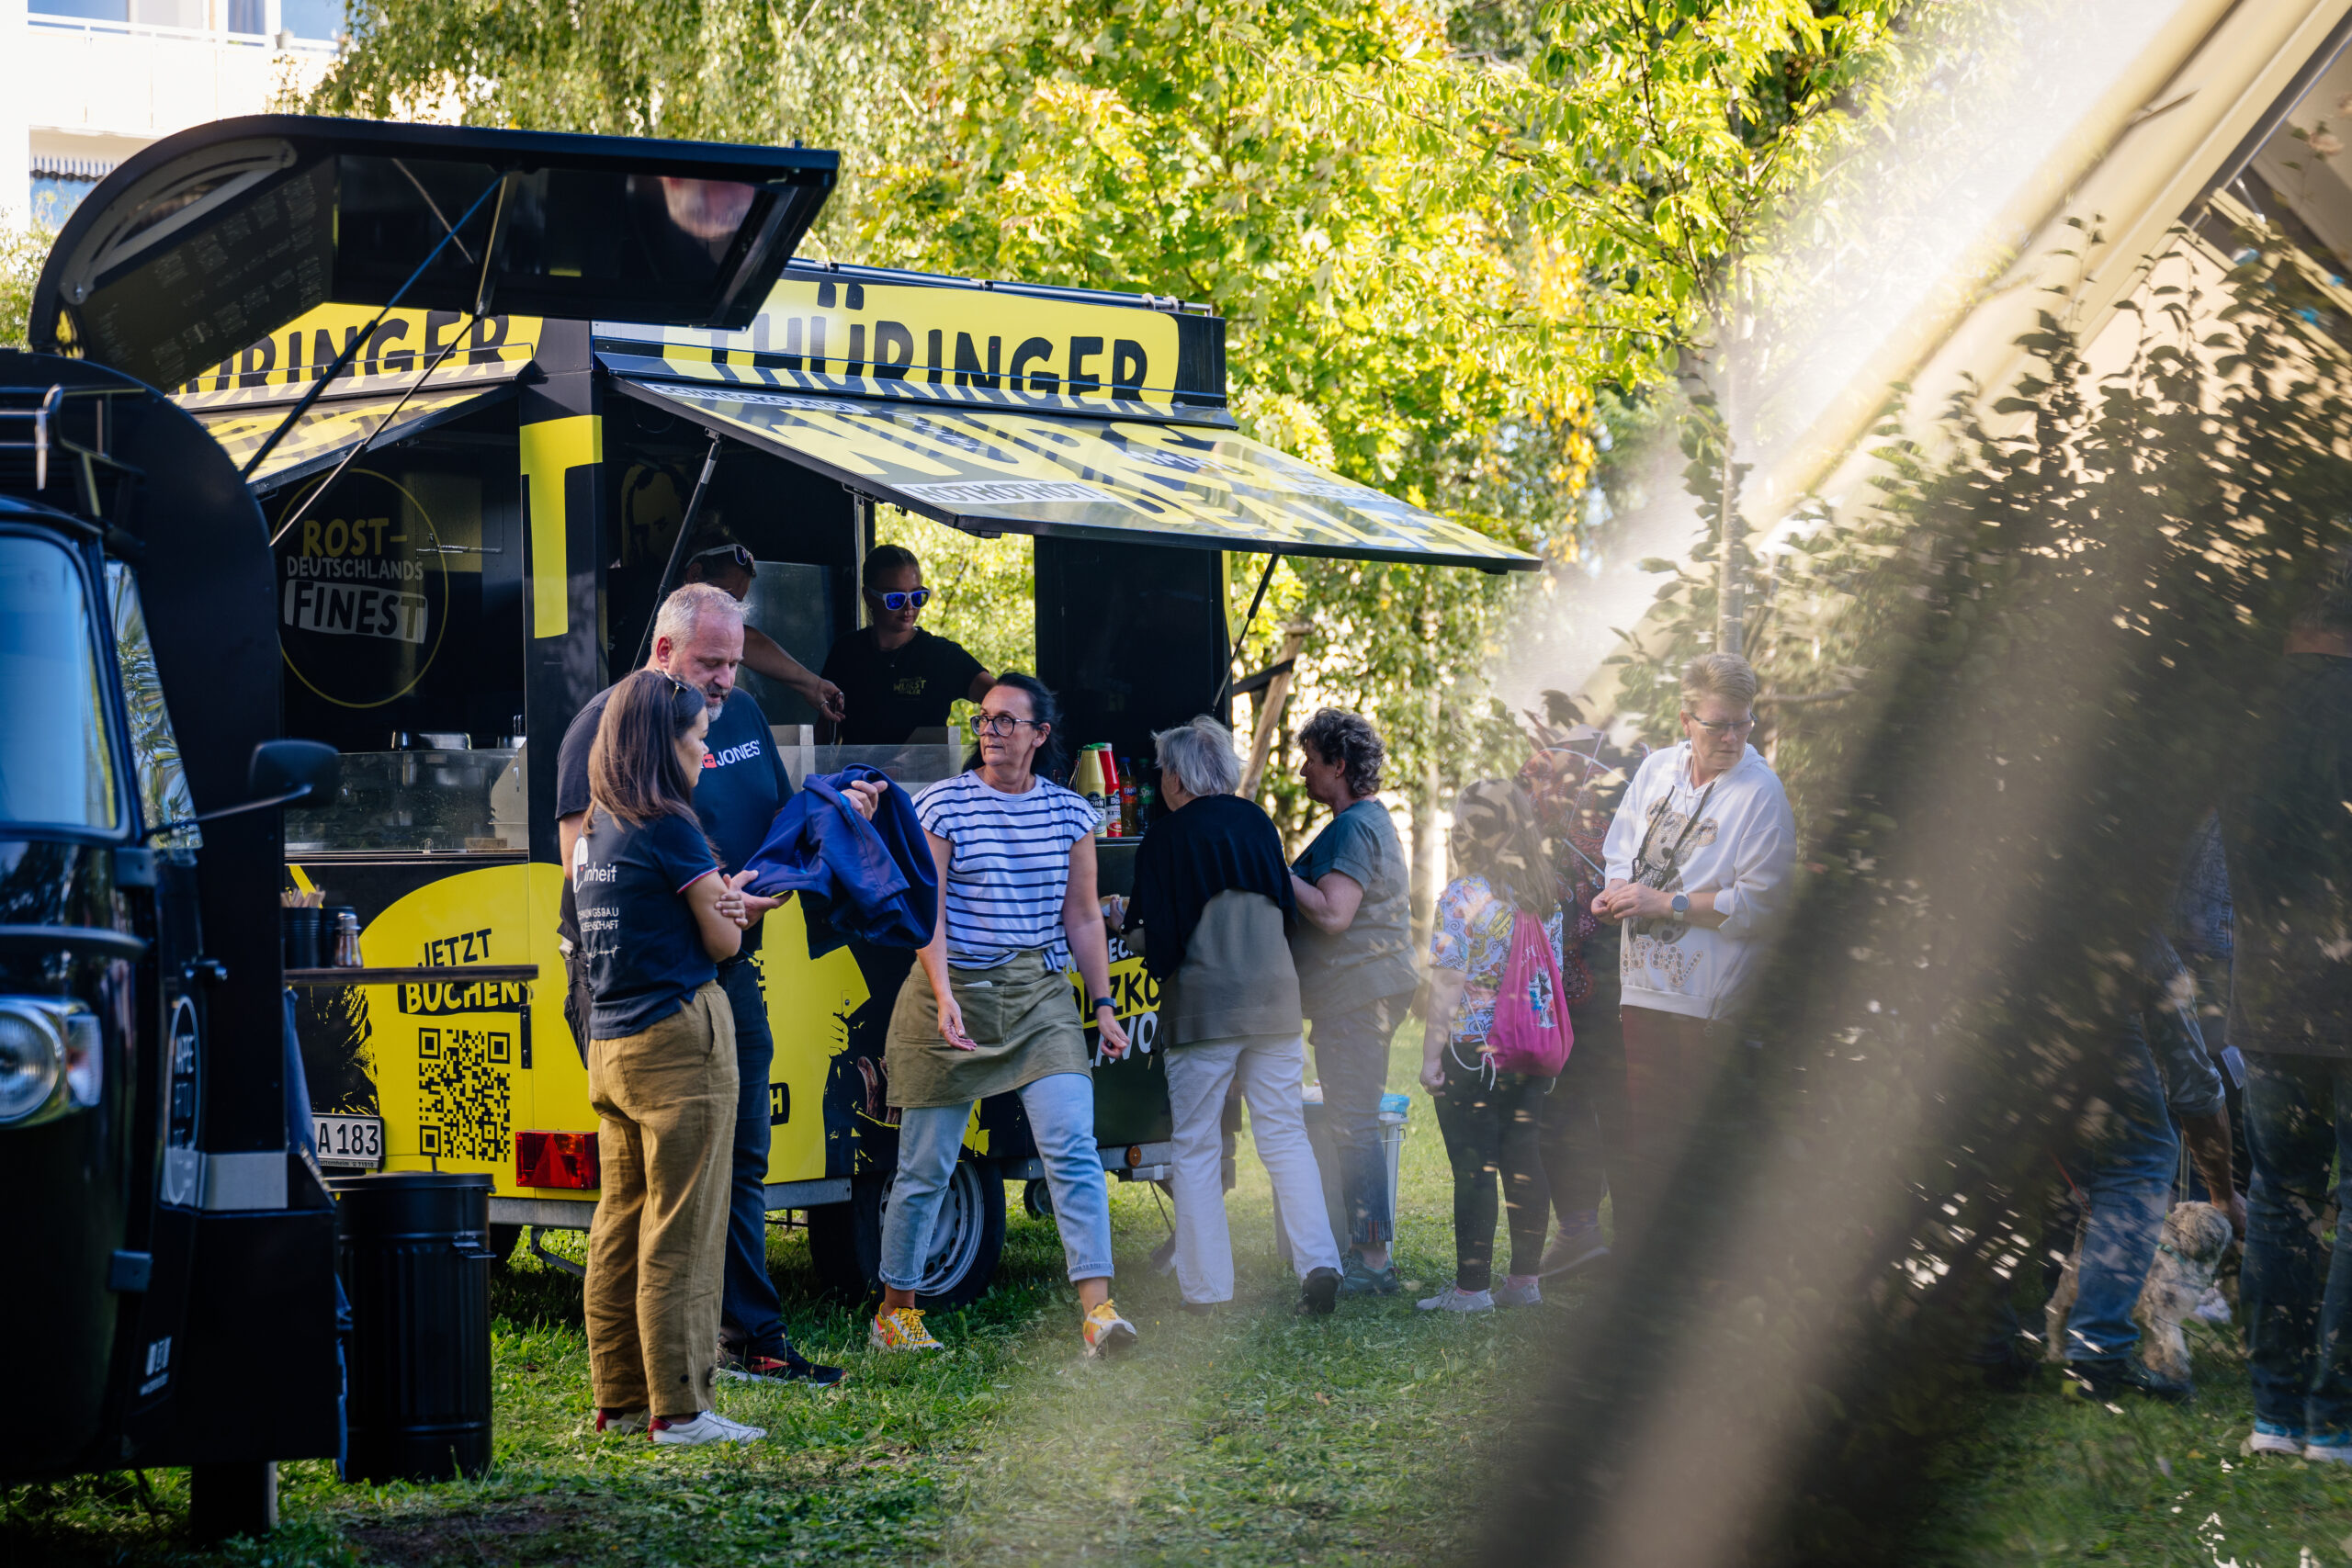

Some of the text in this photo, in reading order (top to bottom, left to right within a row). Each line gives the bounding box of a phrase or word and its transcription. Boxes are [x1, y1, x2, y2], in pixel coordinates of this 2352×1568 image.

[693, 281, 1156, 412] THÜRINGER
[302, 517, 408, 558] ROST-
[287, 556, 424, 581] DEUTSCHLANDS
[292, 581, 426, 639] FINEST
[717, 740, 761, 766] JONES
[417, 928, 492, 967] JETZT
[337, 1123, 379, 1156] 183
